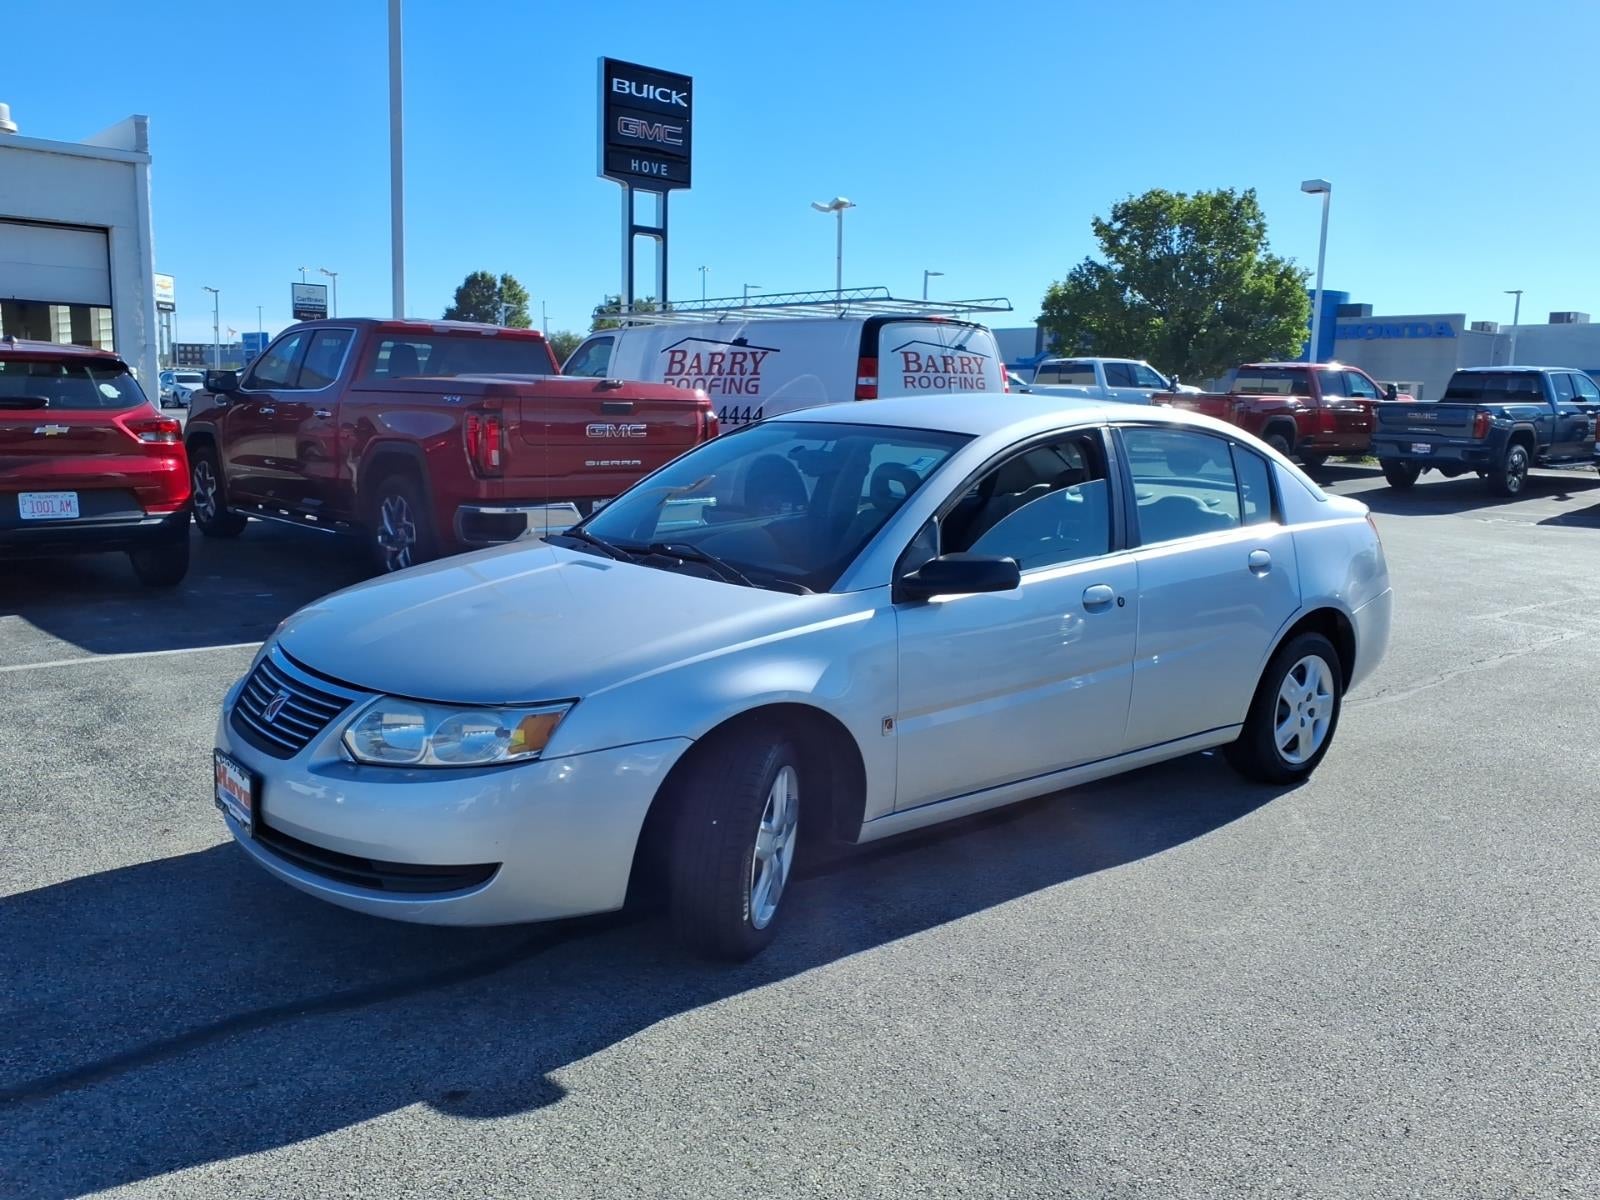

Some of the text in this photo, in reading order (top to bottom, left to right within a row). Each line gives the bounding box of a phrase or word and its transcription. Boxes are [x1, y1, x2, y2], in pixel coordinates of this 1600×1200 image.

[612, 77, 688, 107] BUICK
[618, 116, 683, 146] GMC
[631, 158, 668, 176] HOVE
[1336, 321, 1457, 340] HONDA
[664, 349, 768, 376] BARRY
[900, 351, 985, 375] BARRY
[903, 375, 986, 390] ROOFING
[585, 423, 648, 438] GMC
[30, 499, 73, 514] 1001 AM
